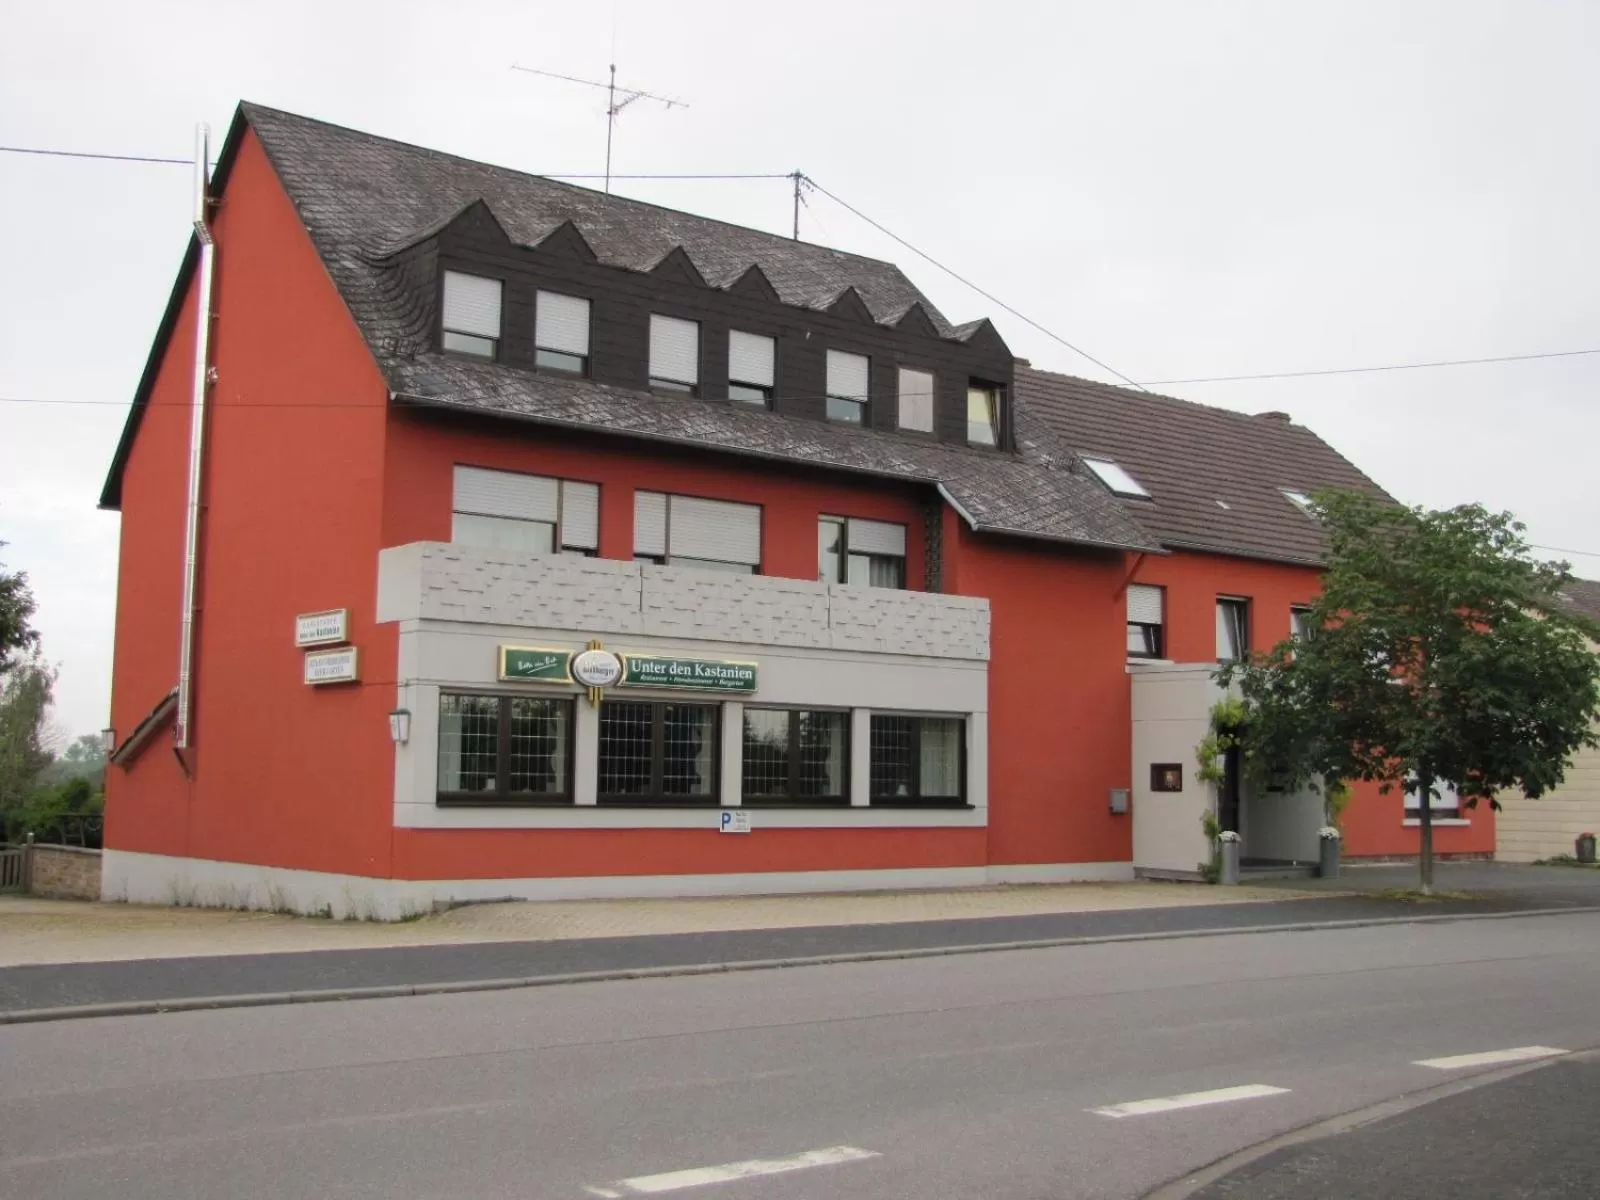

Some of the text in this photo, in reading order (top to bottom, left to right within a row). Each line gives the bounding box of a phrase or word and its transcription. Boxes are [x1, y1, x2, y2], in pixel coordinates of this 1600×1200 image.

[631, 659, 753, 680] Unter den Kastanien
[721, 813, 732, 830] P
